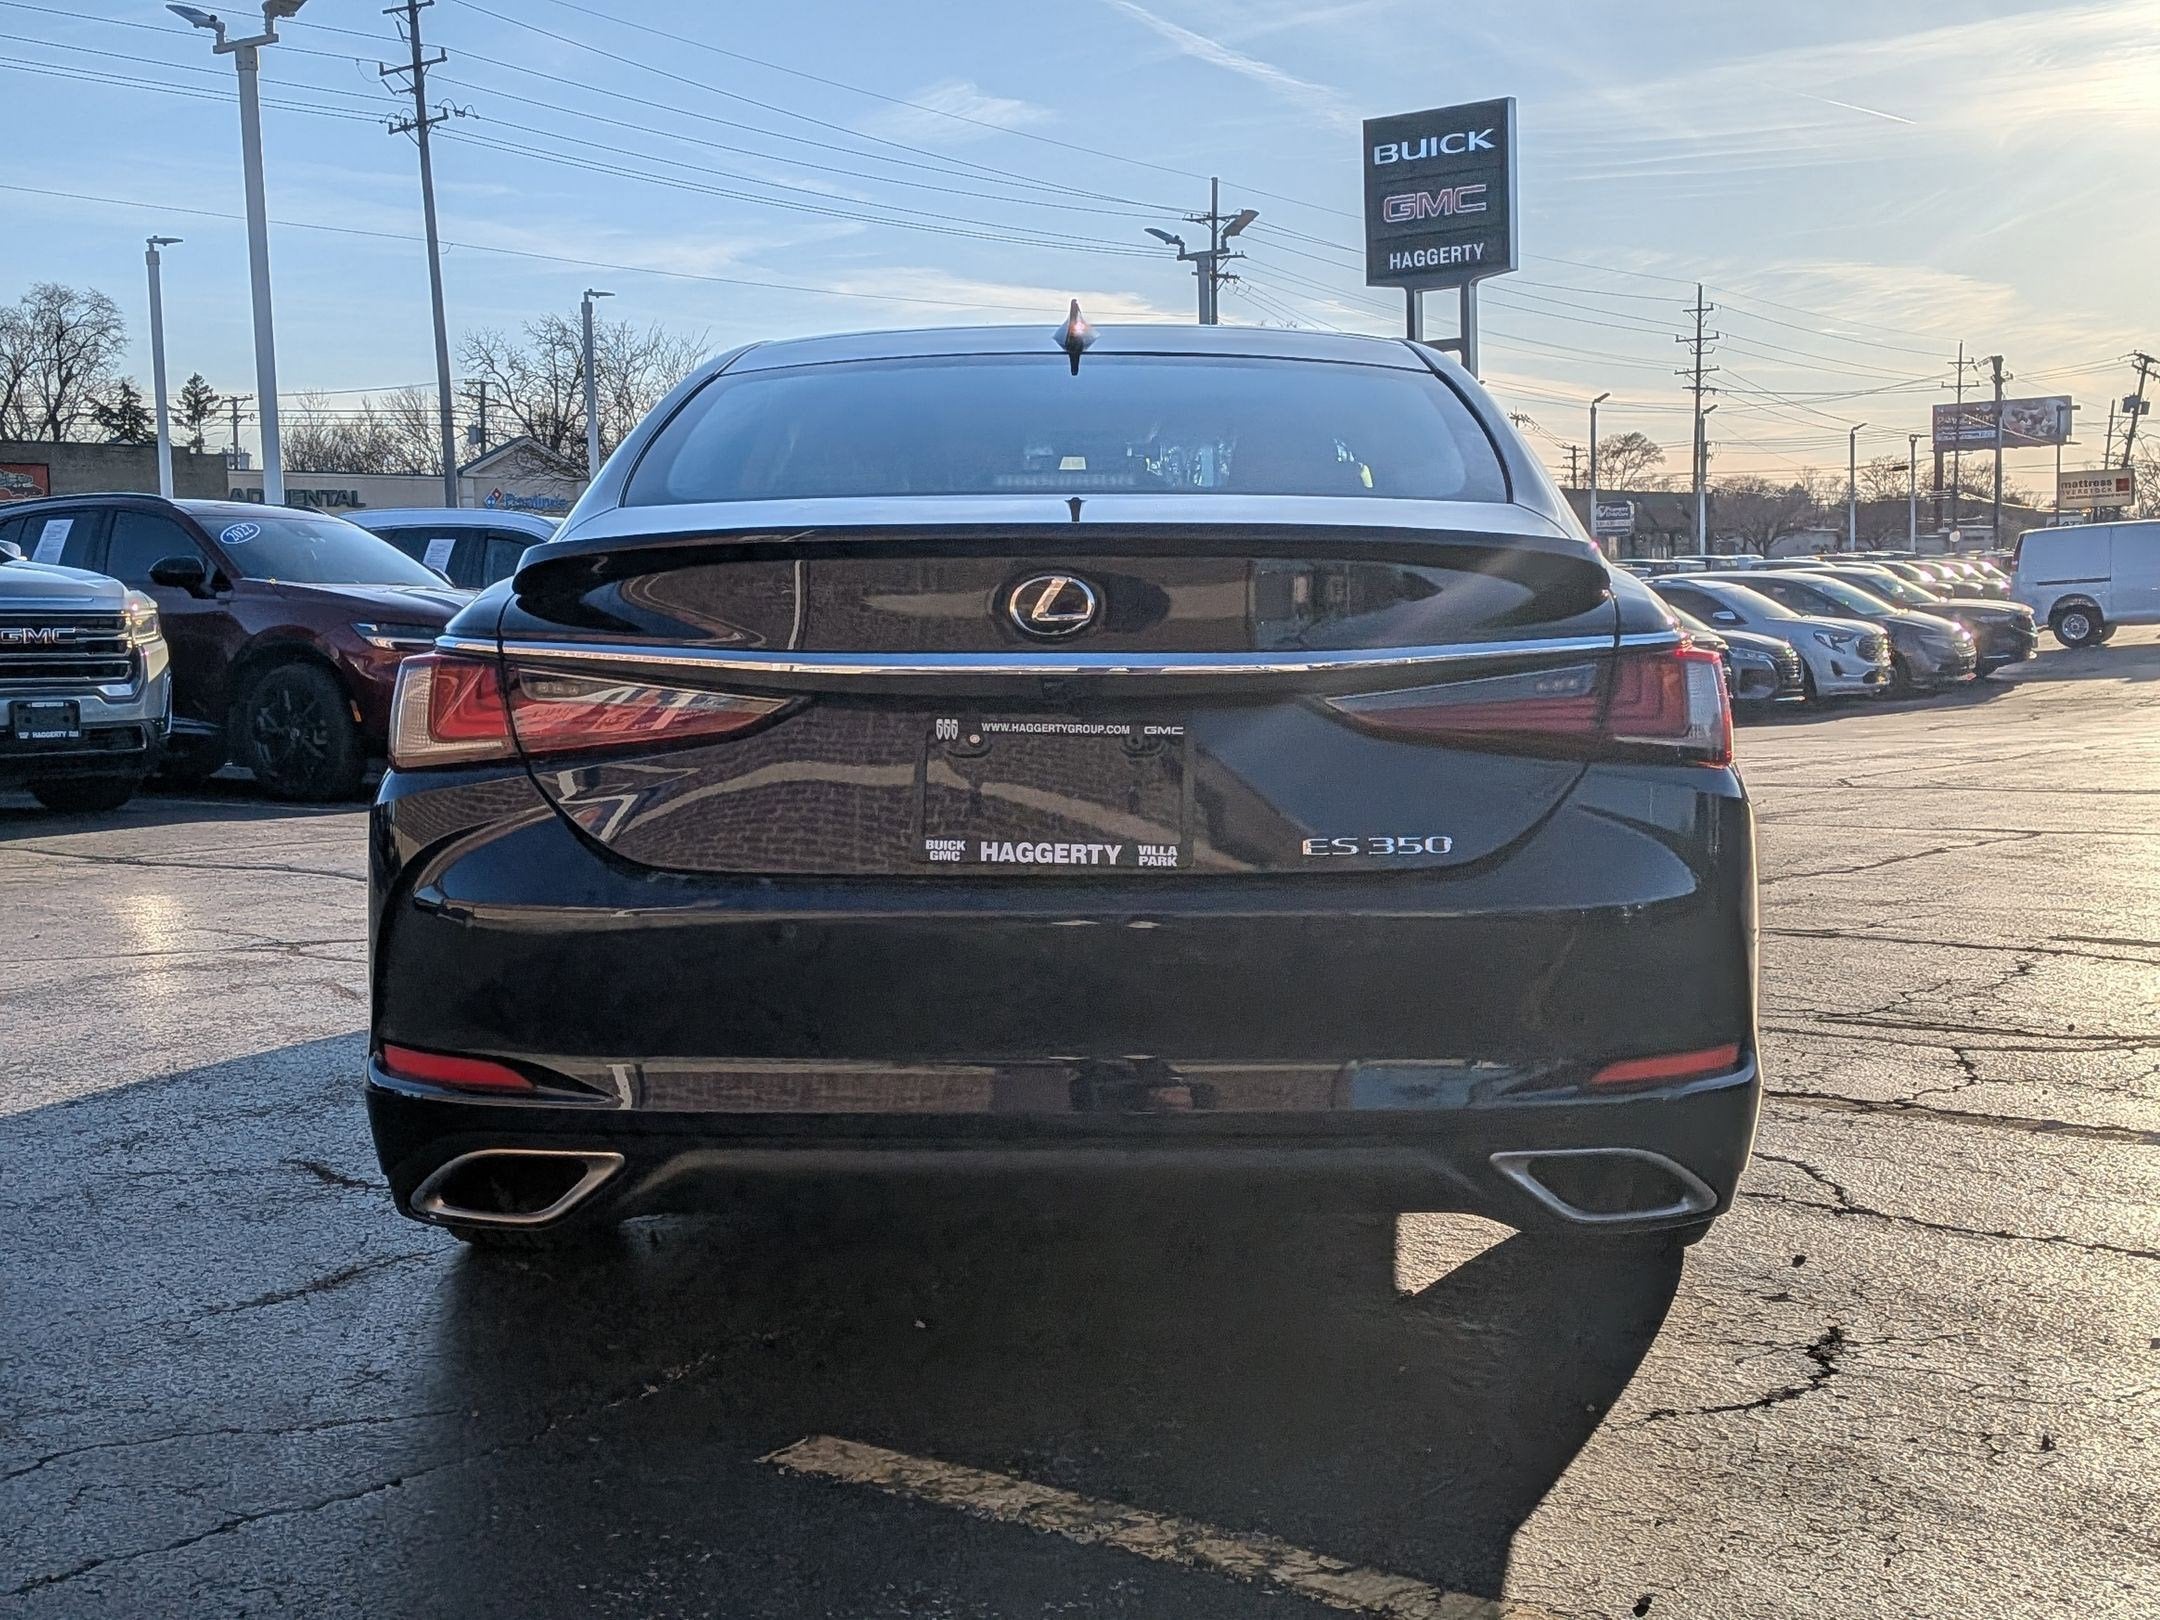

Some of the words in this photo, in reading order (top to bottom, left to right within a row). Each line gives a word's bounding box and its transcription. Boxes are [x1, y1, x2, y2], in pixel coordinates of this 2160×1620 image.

[1374, 128, 1496, 165] BUICK
[1383, 184, 1487, 223] GMC
[1389, 243, 1485, 270] HAGGERTY
[2060, 480, 2113, 489] mattress
[226, 523, 254, 541] 2022
[0, 628, 76, 644] GMC
[981, 722, 1130, 735] WWW.HAGGERTYGROUP.COM
[1143, 726, 1184, 735] GMC
[925, 839, 966, 851] BUICK
[1138, 845, 1178, 856] VILLA
[1302, 838, 1360, 856] ES
[1368, 836, 1453, 855] 350
[929, 850, 961, 862] GMC
[980, 841, 1122, 865] HAGGERTY
[1138, 855, 1178, 867] PARK
